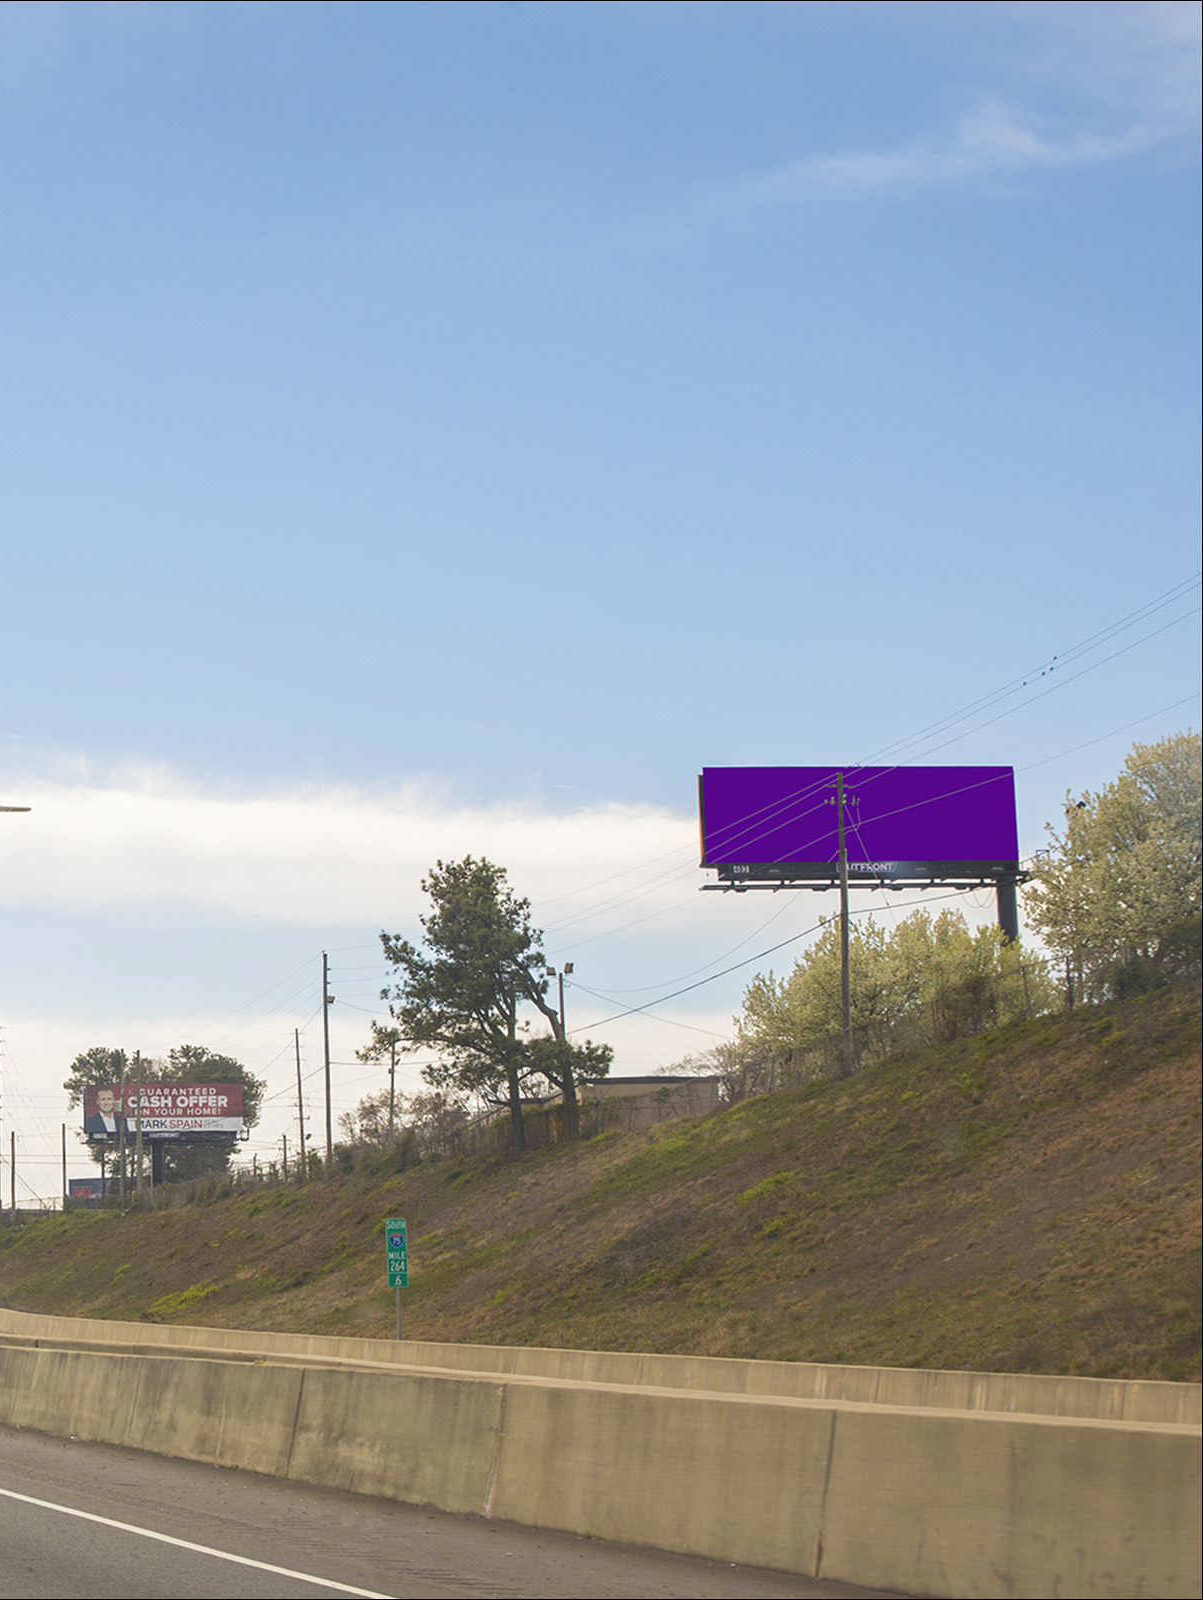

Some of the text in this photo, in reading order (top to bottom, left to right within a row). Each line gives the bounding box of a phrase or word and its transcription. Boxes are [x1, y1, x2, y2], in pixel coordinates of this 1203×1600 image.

[139, 1087, 217, 1096] GUARANTEED
[127, 1095, 228, 1108] CASH OFFER
[154, 1108, 183, 1116] YOUR
[187, 1107, 222, 1116] HOME!
[169, 1119, 203, 1129] SPAIN
[392, 1236, 402, 1245] 75
[388, 1251, 406, 1260] MILE
[390, 1261, 405, 1272] 264
